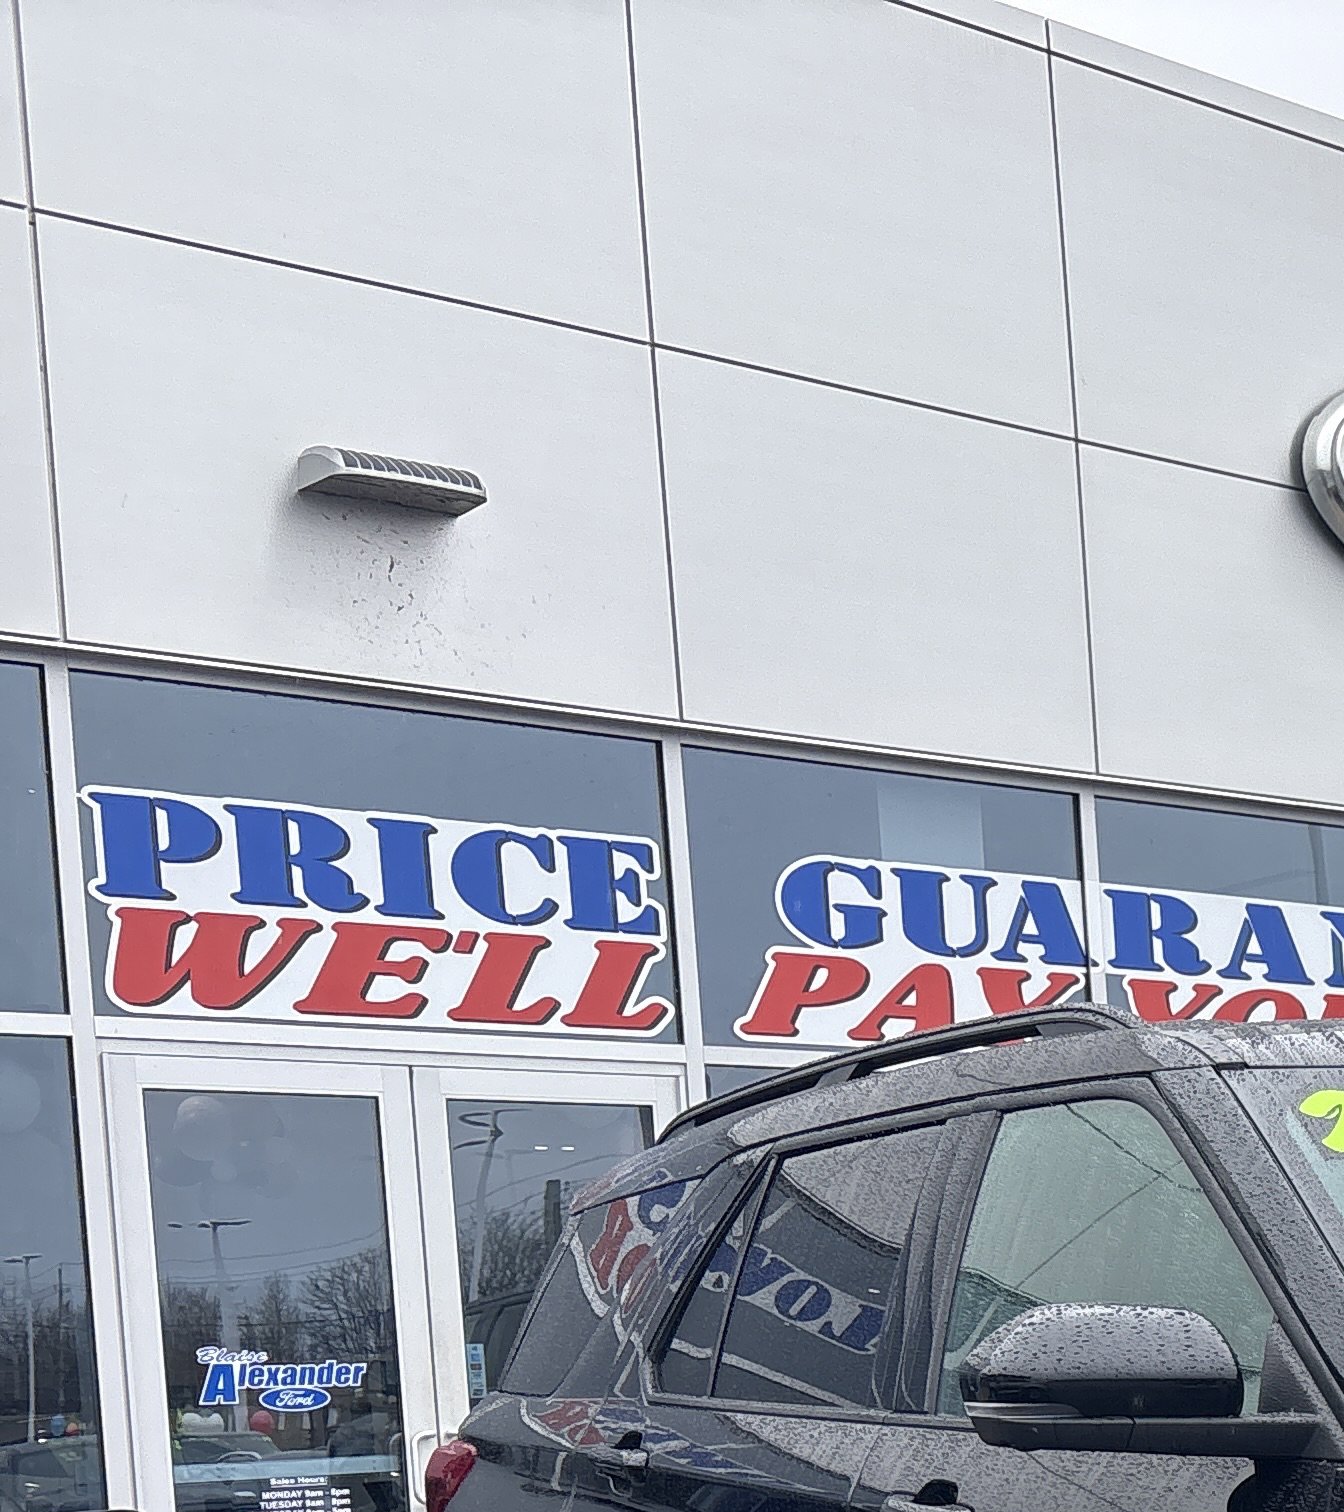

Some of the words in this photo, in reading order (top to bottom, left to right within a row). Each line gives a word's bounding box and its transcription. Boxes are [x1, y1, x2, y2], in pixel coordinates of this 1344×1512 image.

[88, 791, 662, 936] PRICE
[111, 905, 670, 1030] WE'LL
[196, 1346, 269, 1364] Blaise
[199, 1360, 367, 1405] Alexander
[275, 1390, 315, 1406] Ford
[261, 1490, 303, 1500] MONDAY
[259, 1500, 304, 1510] TUESDAY
